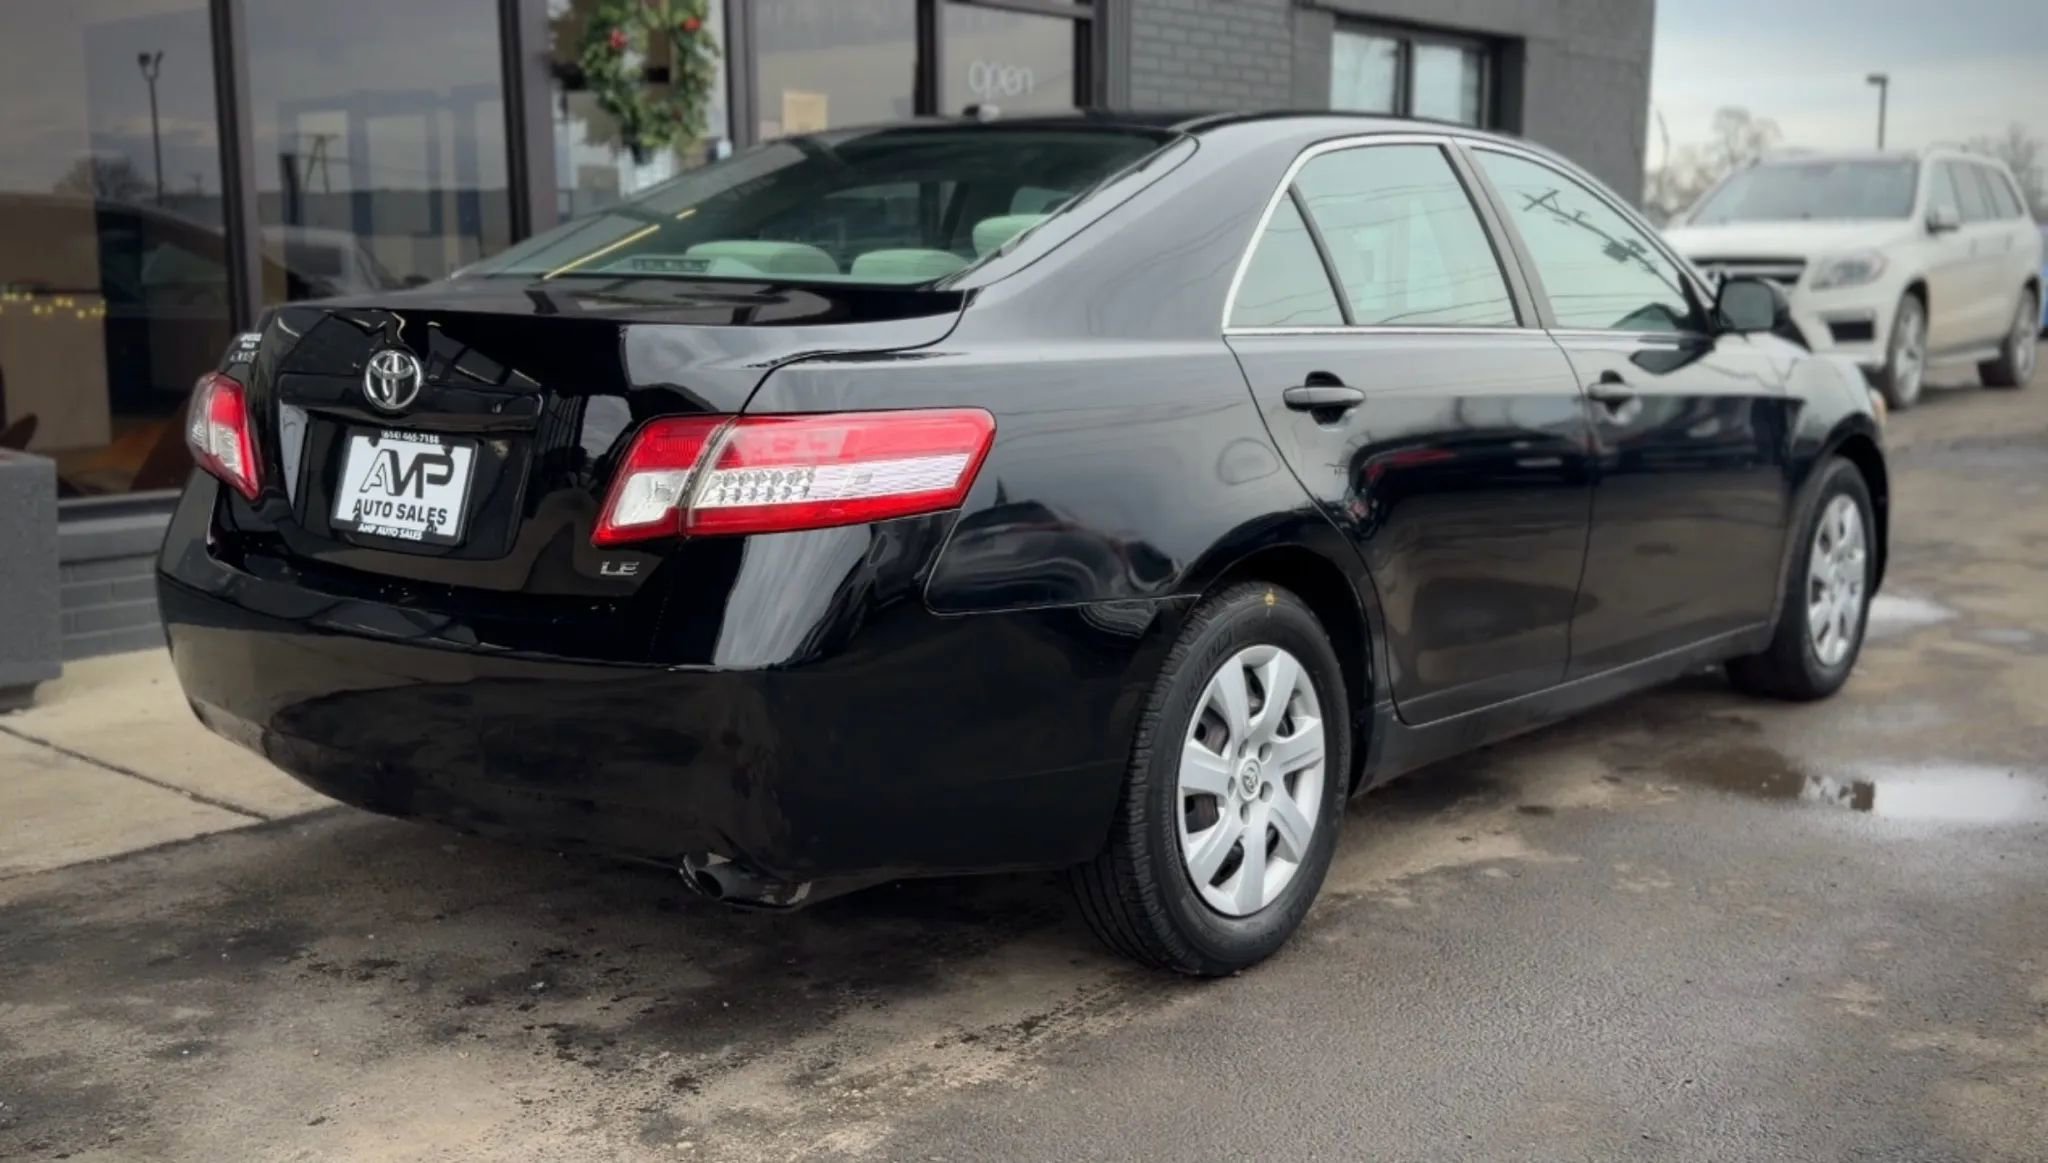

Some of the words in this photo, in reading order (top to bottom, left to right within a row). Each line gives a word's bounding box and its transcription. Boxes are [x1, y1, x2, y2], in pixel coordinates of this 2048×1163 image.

[968, 60, 1034, 101] Open
[352, 498, 393, 518] AUTO
[395, 503, 448, 526] SALES
[376, 526, 399, 537] AUTO
[399, 529, 422, 541] SALES
[600, 561, 640, 576] LE
